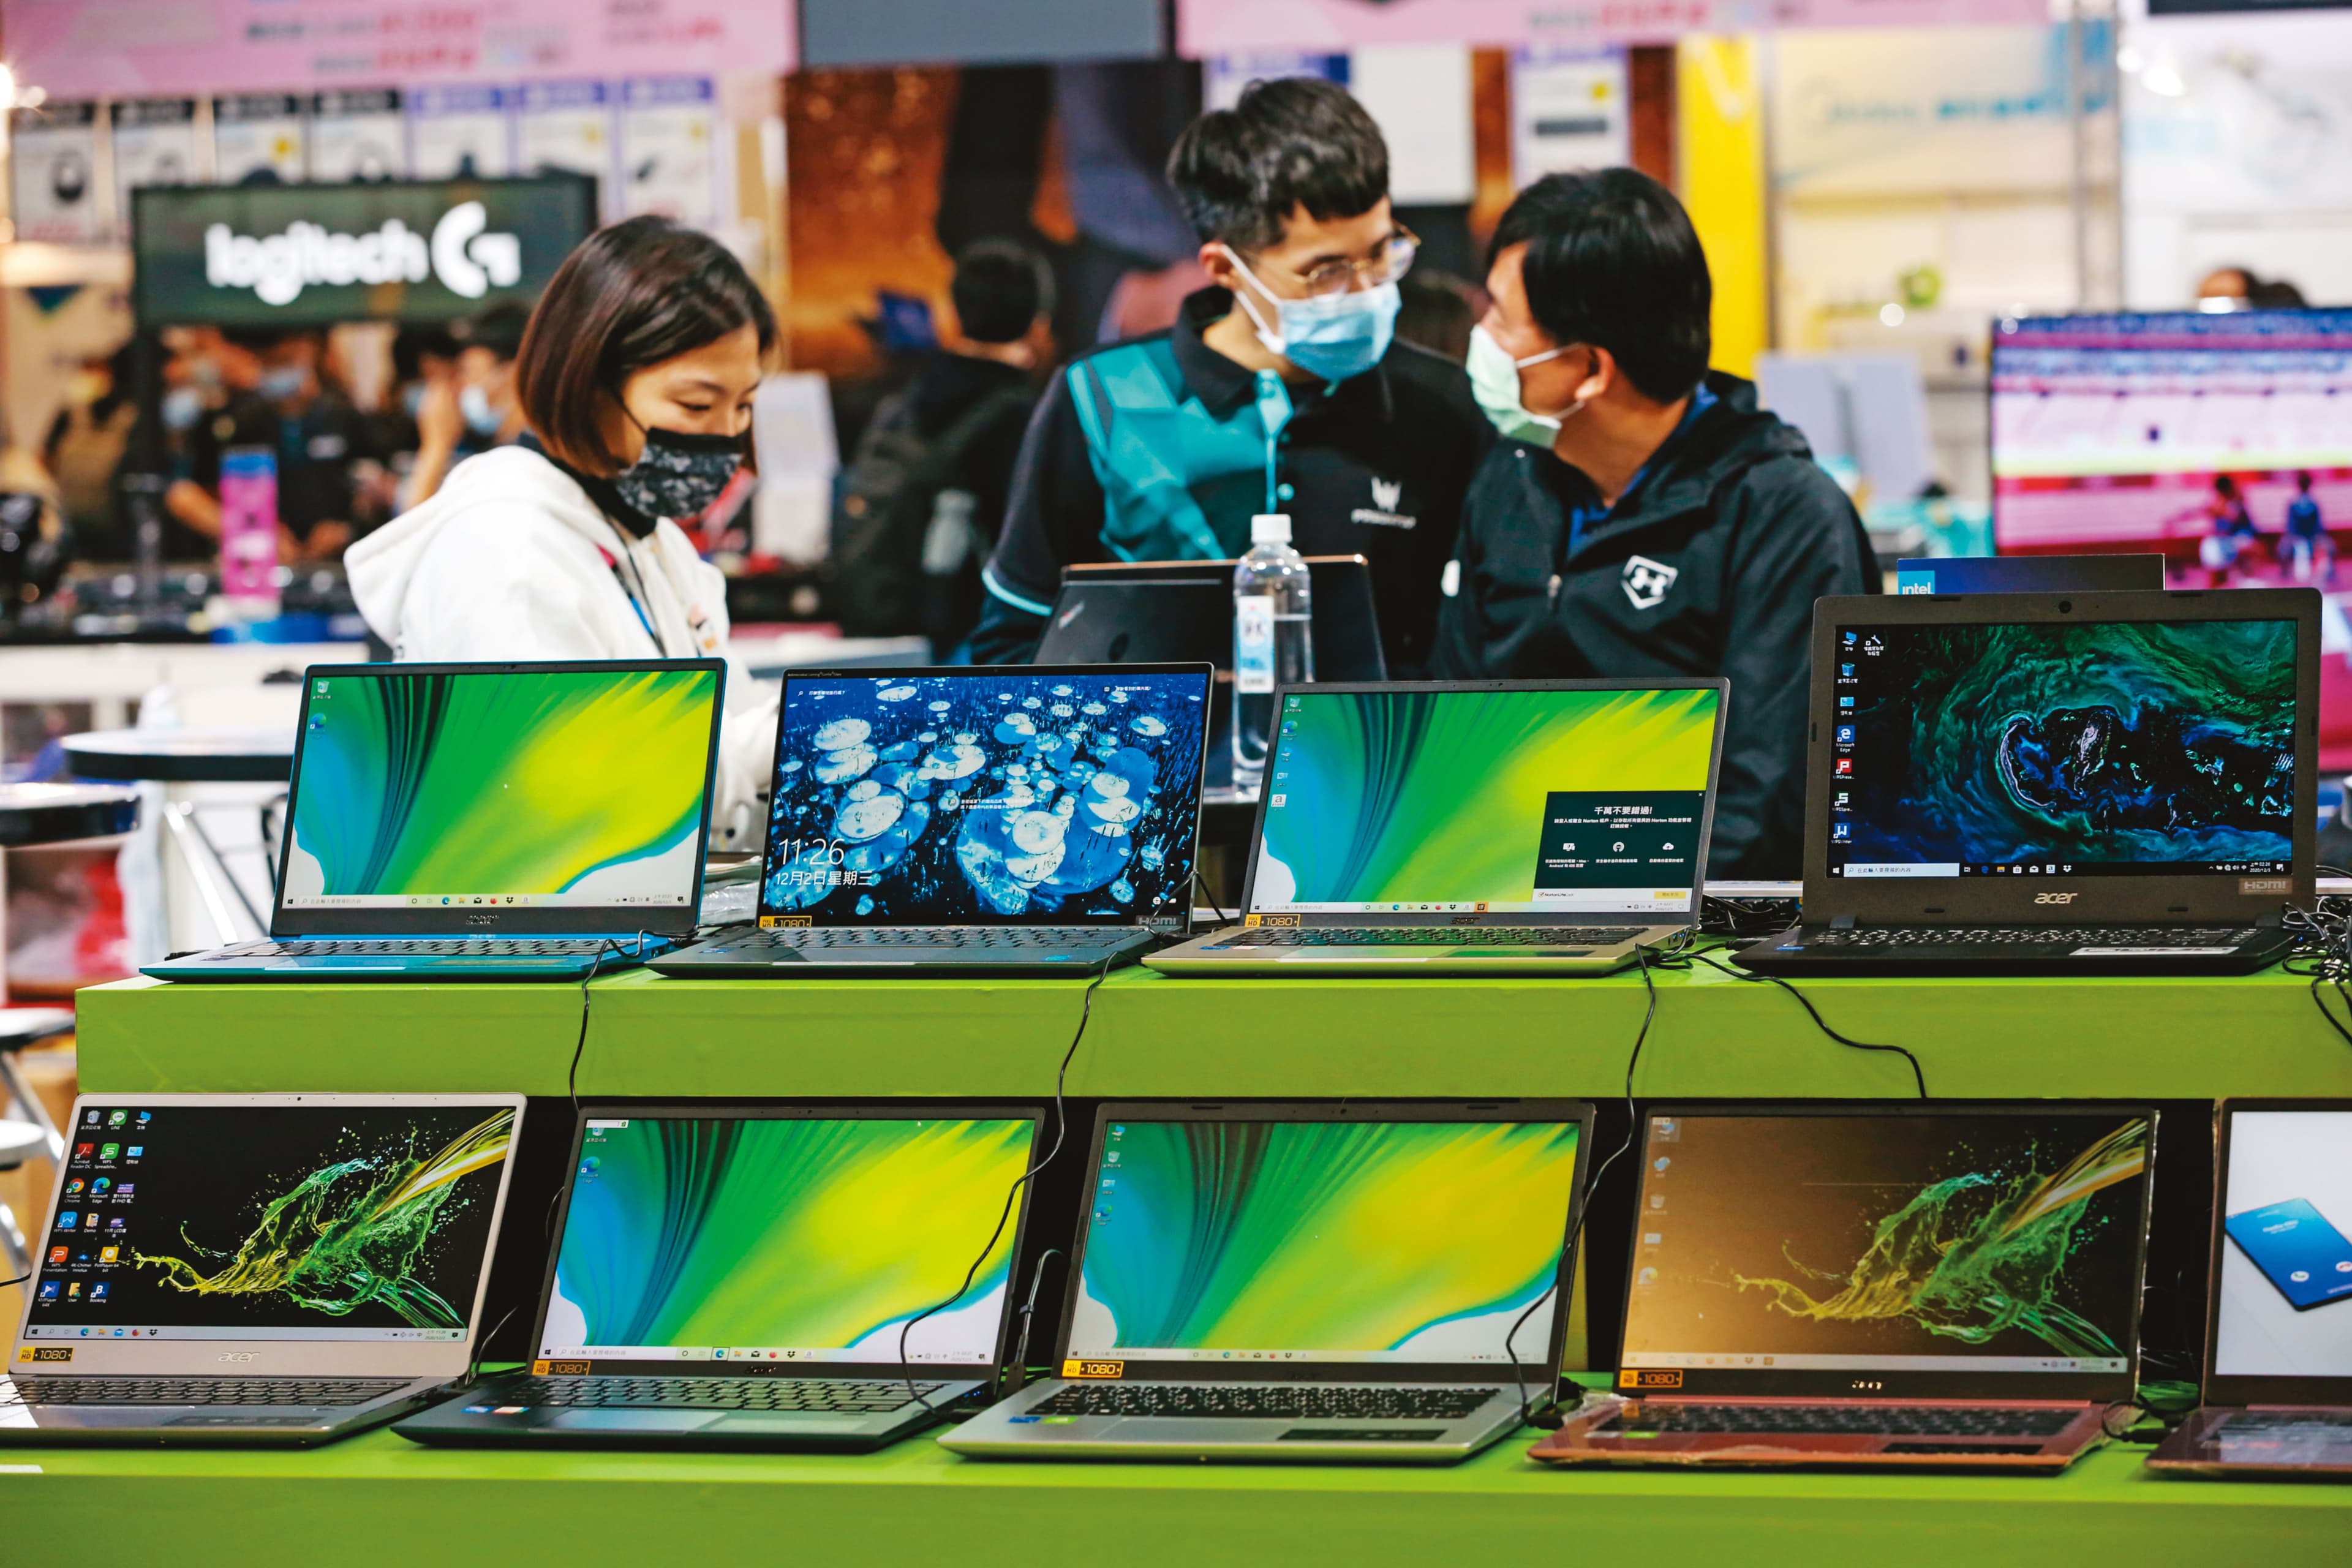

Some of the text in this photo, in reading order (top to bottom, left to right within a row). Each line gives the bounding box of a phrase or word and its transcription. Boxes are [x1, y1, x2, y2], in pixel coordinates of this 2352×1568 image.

[1902, 582, 1931, 594] intel
[1594, 806, 1652, 815] 千萬不要錯過!
[779, 839, 845, 865] 11:26
[775, 870, 873, 886] 12月2日星期三
[2244, 881, 2286, 889] HDMI
[2034, 893, 2078, 903] acer
[1267, 917, 1293, 926] 1080
[40, 1350, 67, 1359] 1080
[218, 1352, 260, 1362] acer
[555, 1364, 582, 1374] 1080
[1087, 1364, 1115, 1374] 1080
[1645, 1374, 1675, 1384] 1080
